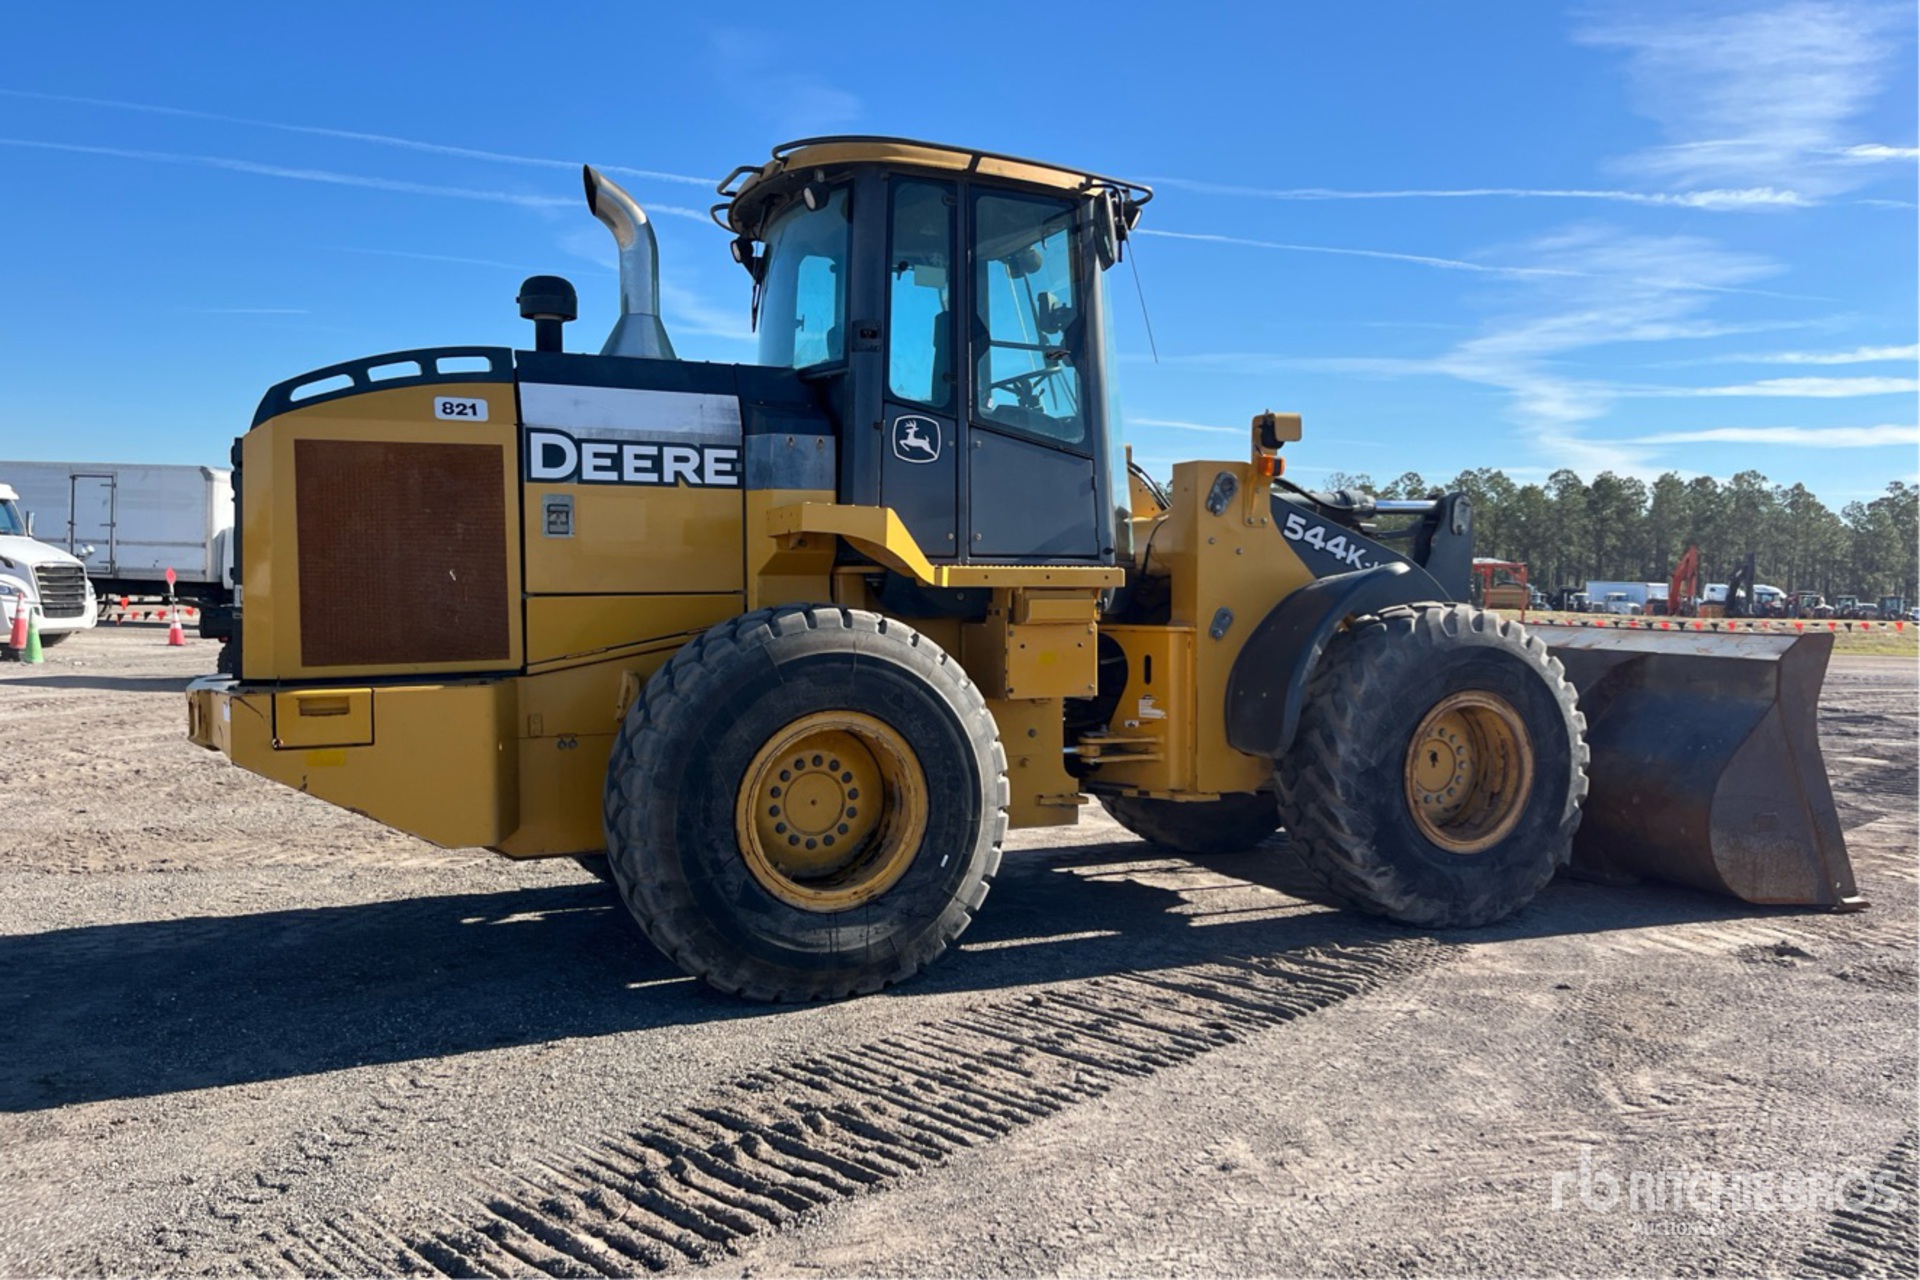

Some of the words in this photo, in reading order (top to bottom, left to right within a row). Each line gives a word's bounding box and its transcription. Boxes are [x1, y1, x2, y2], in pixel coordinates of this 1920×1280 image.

[441, 401, 478, 417] 821
[529, 431, 739, 486] DEERE
[1283, 512, 1384, 570] 544K-
